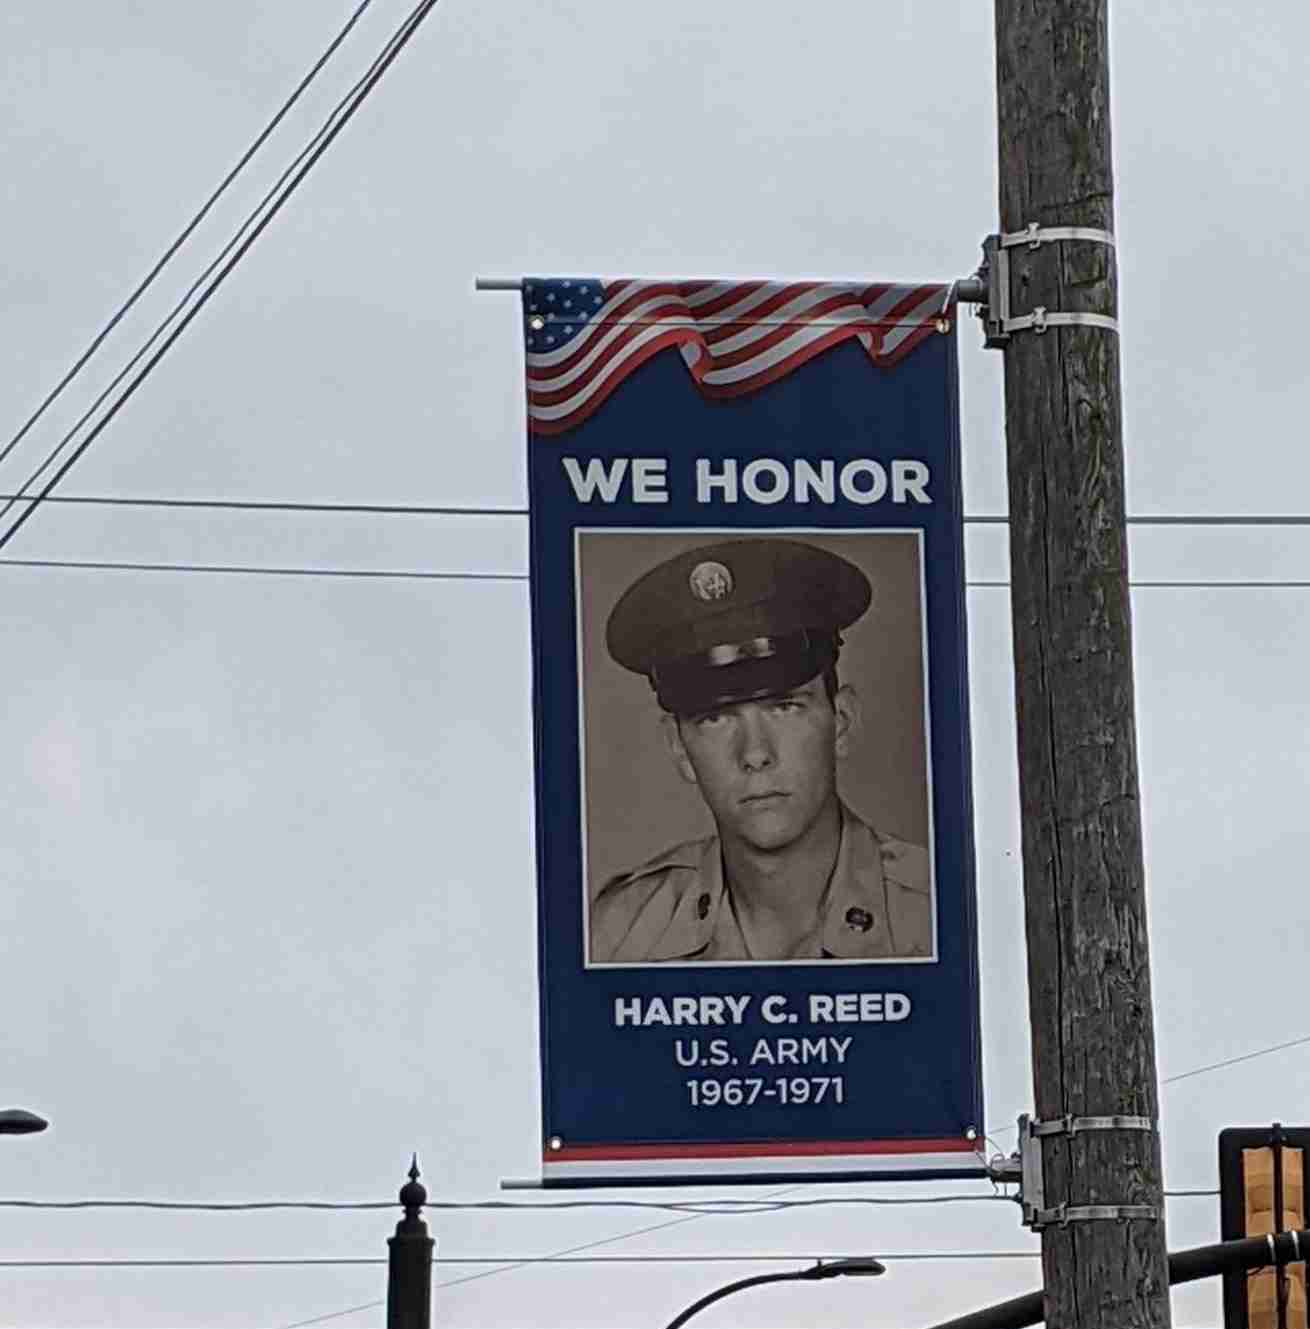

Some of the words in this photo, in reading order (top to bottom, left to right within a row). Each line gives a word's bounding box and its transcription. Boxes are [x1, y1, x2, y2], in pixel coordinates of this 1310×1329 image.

[562, 457, 669, 504] WE
[694, 457, 932, 505] HONOR
[614, 994, 750, 1026] HARRY
[760, 994, 798, 1024] C.
[808, 992, 912, 1023] REED
[674, 1039, 738, 1067] U.S.
[750, 1036, 852, 1065] ARMY
[686, 1076, 844, 1106] 1967-1971
